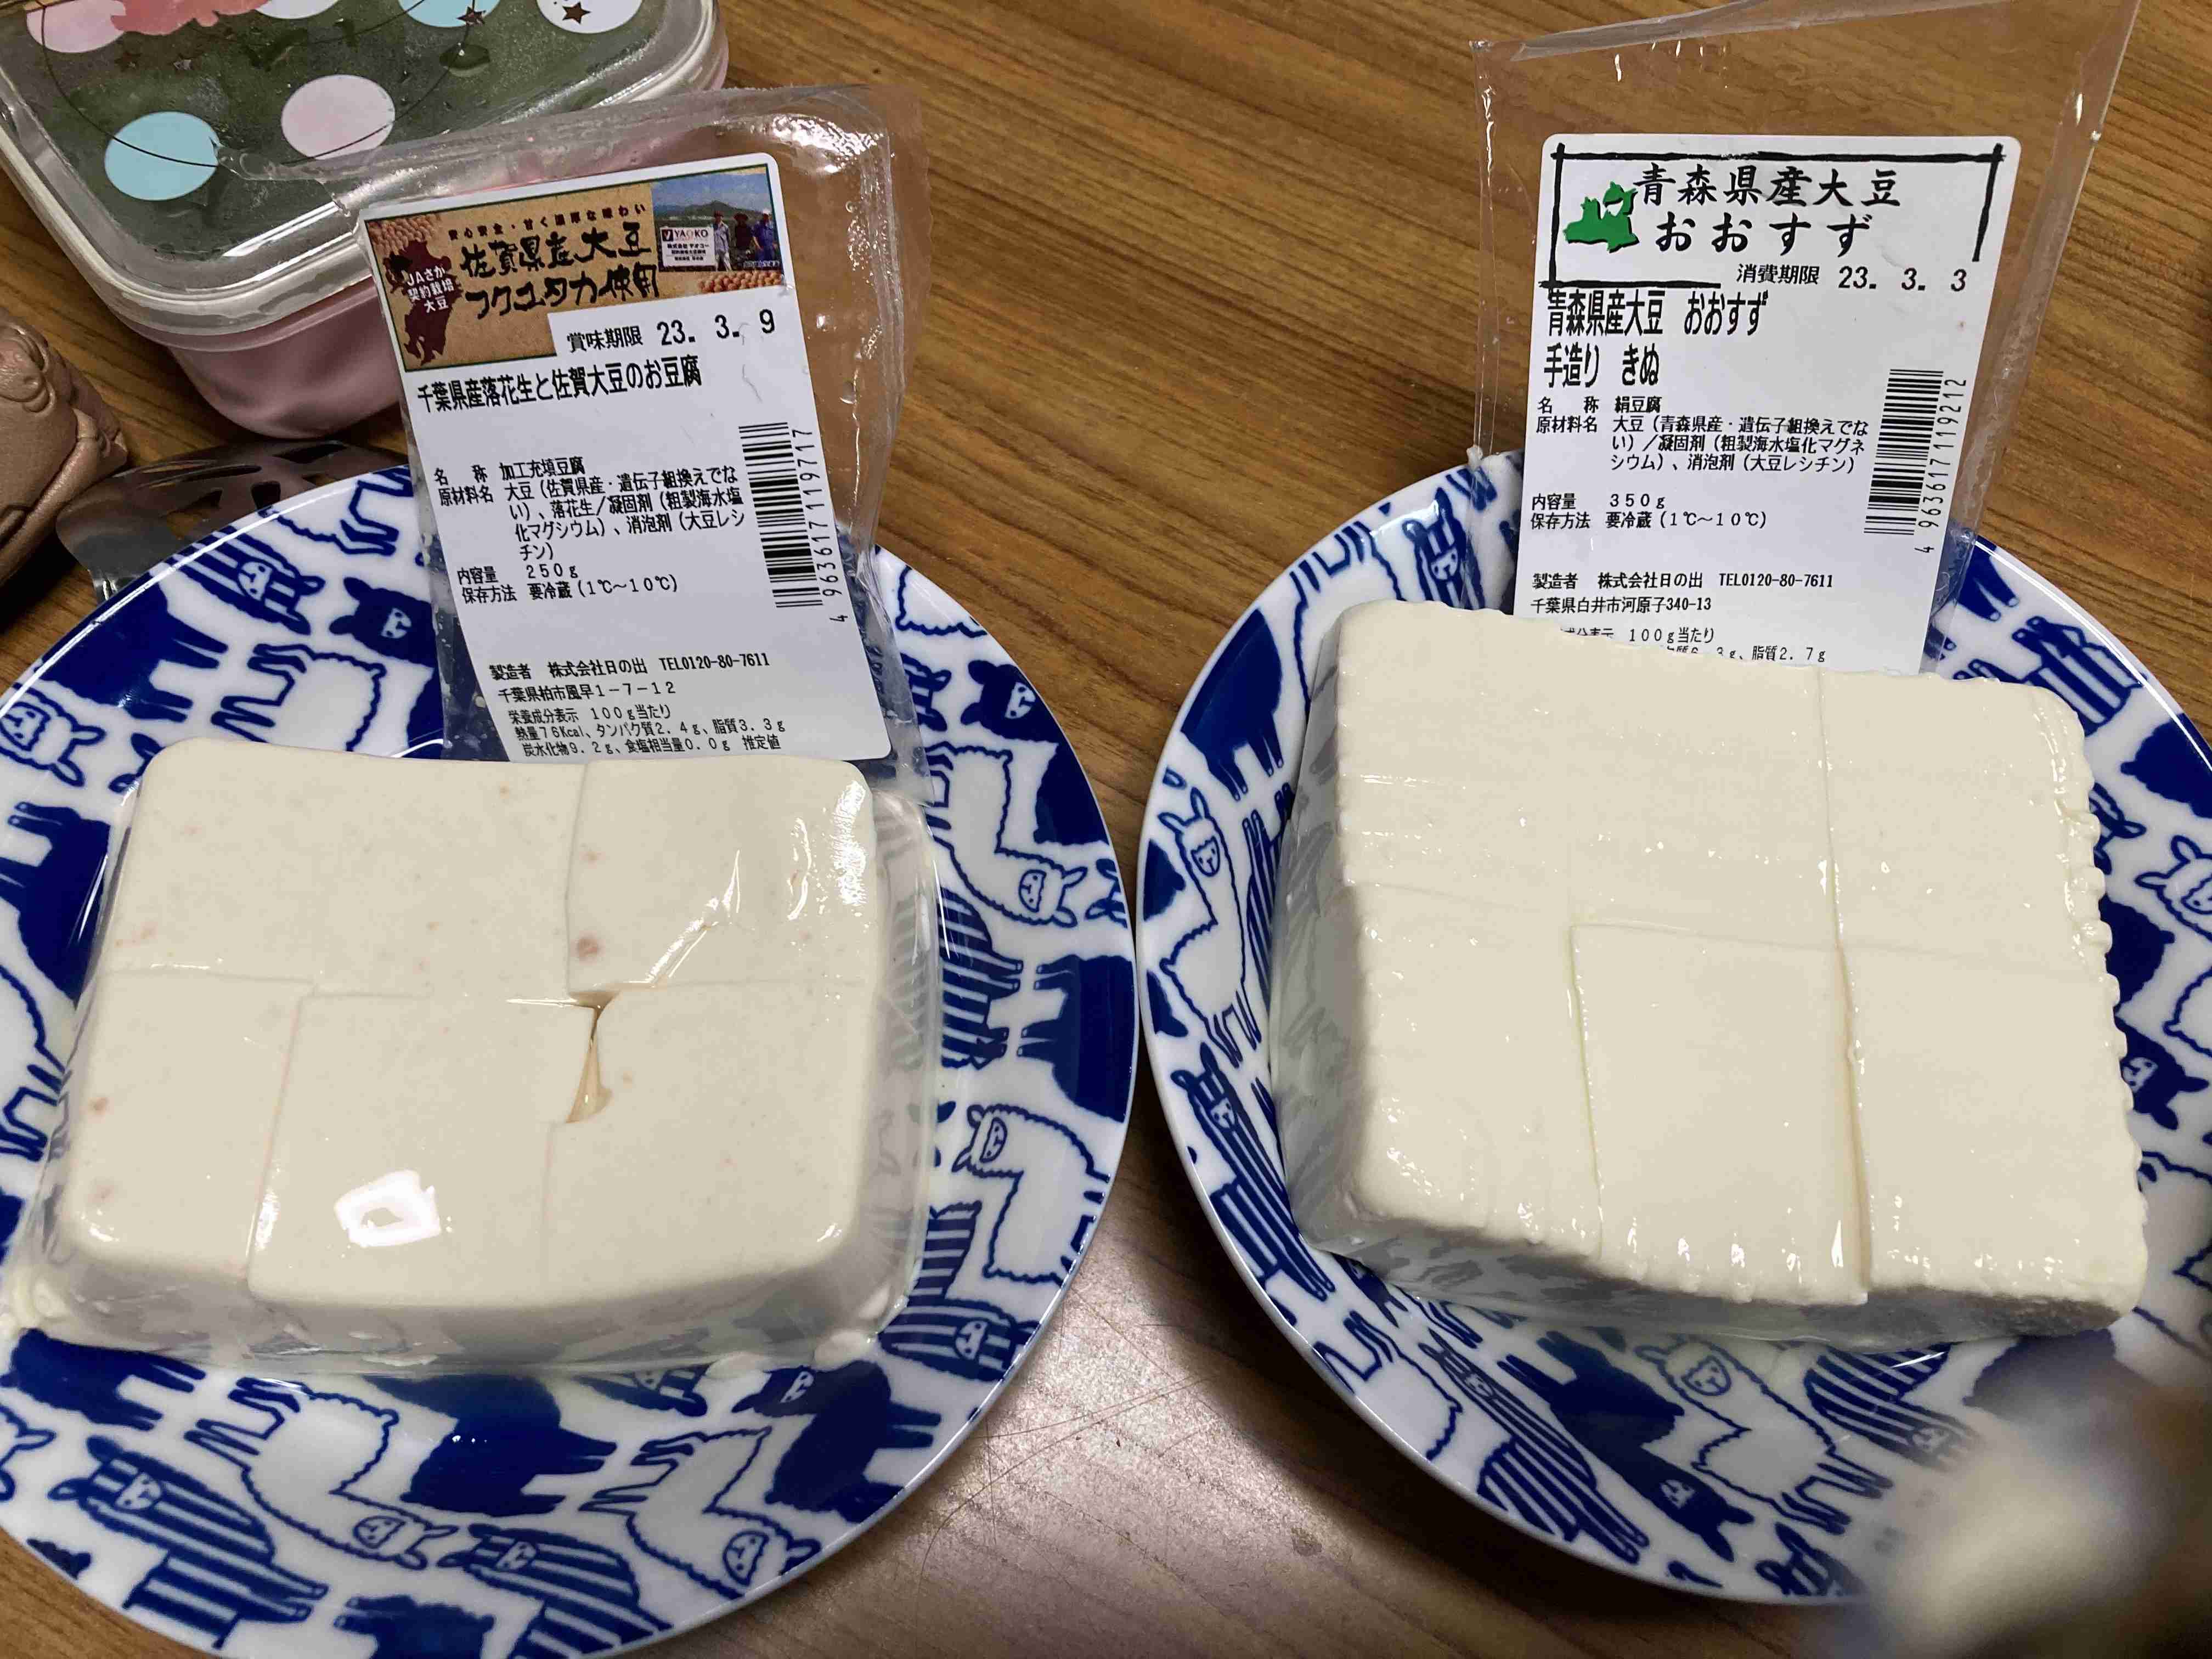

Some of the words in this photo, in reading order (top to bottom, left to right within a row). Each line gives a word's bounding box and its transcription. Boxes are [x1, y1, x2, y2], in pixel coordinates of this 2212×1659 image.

[1637, 162, 1901, 207] 青森県産大豆
[1655, 212, 1871, 257] おおすず
[460, 221, 652, 278] 佐賀県産大豆
[407, 263, 445, 286] JAさが
[1736, 263, 1820, 285] 消費期限
[1950, 268, 1967, 291] 3
[407, 278, 455, 302] 契約栽培
[424, 295, 449, 313] 大豆
[1548, 289, 1663, 336] 青森県産大豆
[1684, 291, 1769, 336] おおすず
[567, 326, 644, 353] 賞味期限
[759, 308, 775, 334] 9
[1544, 342, 1600, 388] 手造り
[1622, 342, 1660, 386] きぬ
[417, 354, 702, 413] 千葉県産落花生と佐賀大豆のお豆腐
[1615, 395, 1662, 413] 絹豆腐
[1536, 415, 1598, 433] 原材料名
[499, 456, 585, 481] 加工充填豆腐
[438, 485, 494, 507] 原材料名
[1532, 493, 1576, 510] 内容量
[1530, 511, 1590, 529] 保存方法
[457, 566, 499, 585] 内容量
[1532, 572, 1578, 589] 製造者
[1598, 571, 1703, 589] 株式会社日の出
[1719, 573, 1833, 588] TEL0120-80-7611
[461, 584, 517, 604] 保存方法
[1531, 596, 1712, 614] 千葉県白井市河原子340-13
[489, 663, 532, 681] 製造者
[547, 657, 648, 678] 株式会社日の出
[658, 652, 770, 671] TEL0120-80-7611
[508, 707, 579, 725] 栄養成分表示
[741, 733, 782, 751] 推定値
